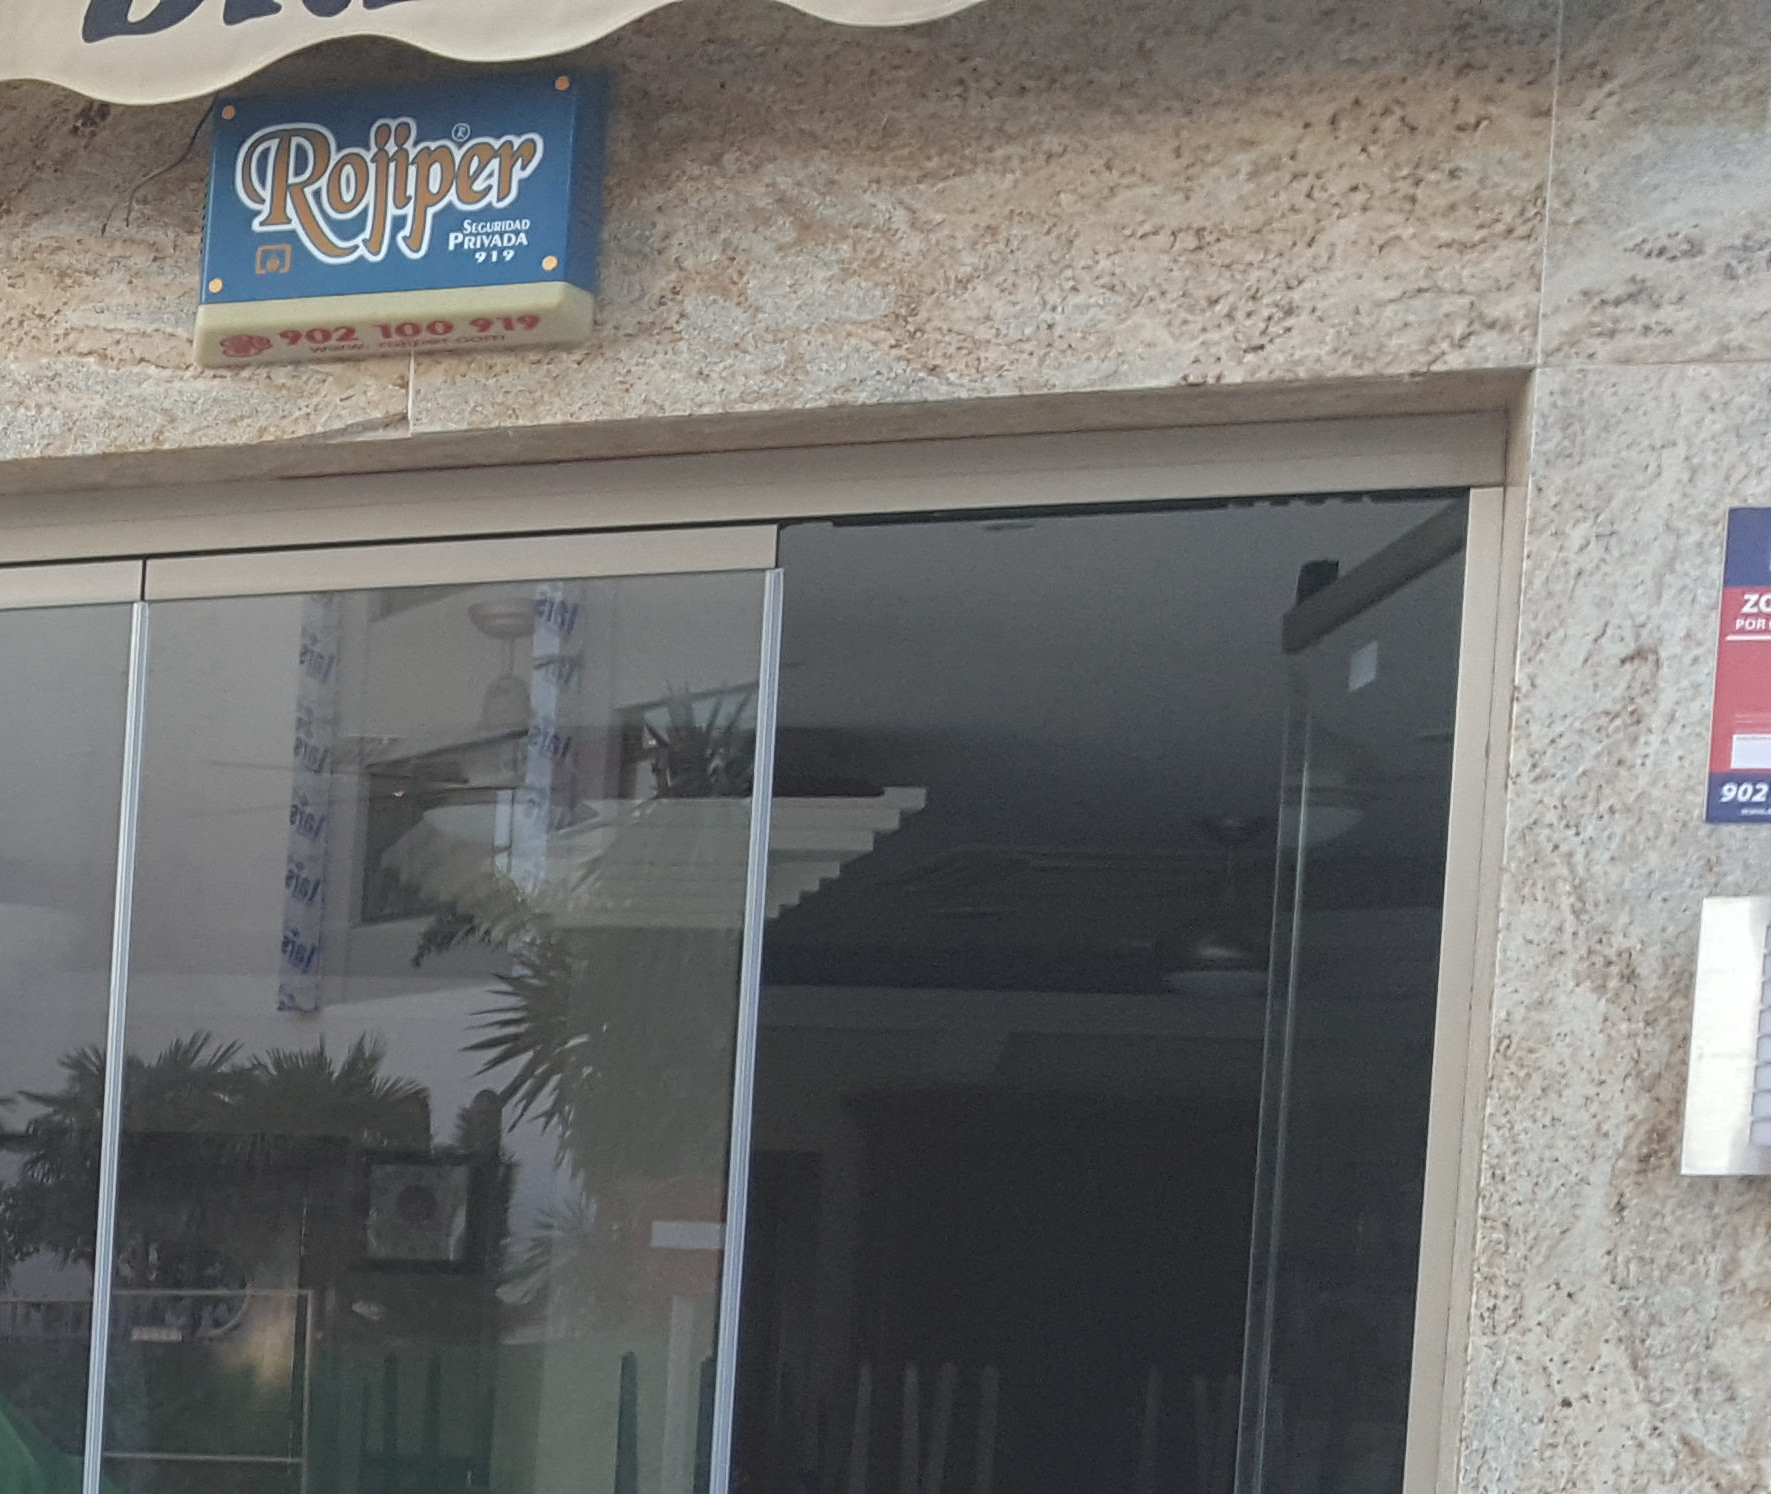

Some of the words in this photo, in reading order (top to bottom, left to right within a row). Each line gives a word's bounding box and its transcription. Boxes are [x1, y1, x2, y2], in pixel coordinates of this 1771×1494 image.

[236, 118, 542, 262] Rojiper
[463, 218, 531, 234] SEGURIDAD
[447, 232, 529, 251] PRIVADA
[474, 249, 516, 264] 919
[279, 325, 360, 346] 902
[377, 319, 454, 341] 100
[468, 313, 541, 334] 919
[1735, 618, 1766, 631] POR
[1720, 781, 1770, 803] 902
